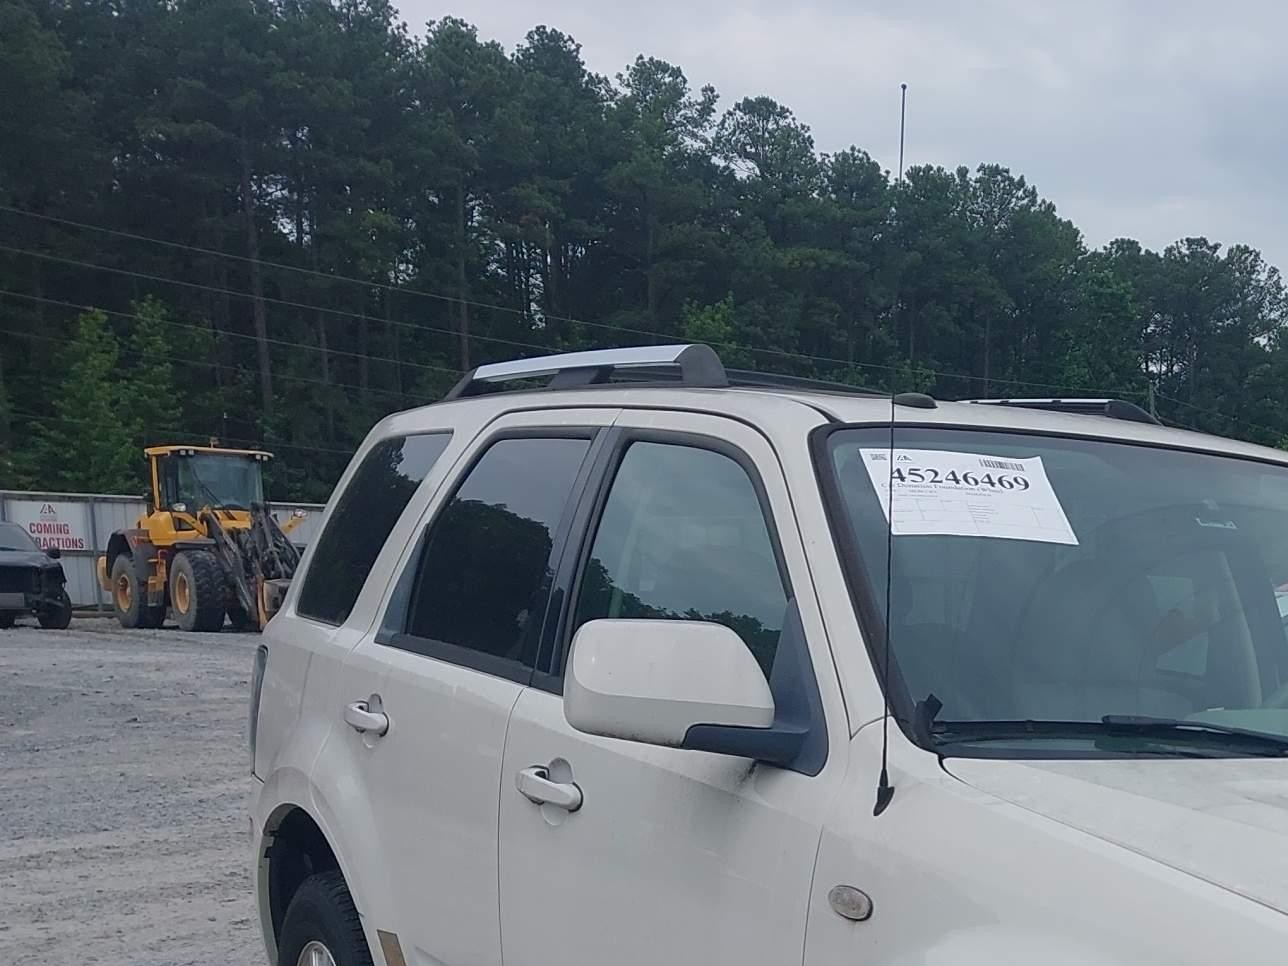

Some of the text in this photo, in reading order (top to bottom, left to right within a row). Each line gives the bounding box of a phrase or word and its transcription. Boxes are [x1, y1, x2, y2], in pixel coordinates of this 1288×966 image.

[891, 467, 1030, 491] 45246469
[29, 522, 70, 534] COMING
[34, 537, 85, 549] RACTIONS
